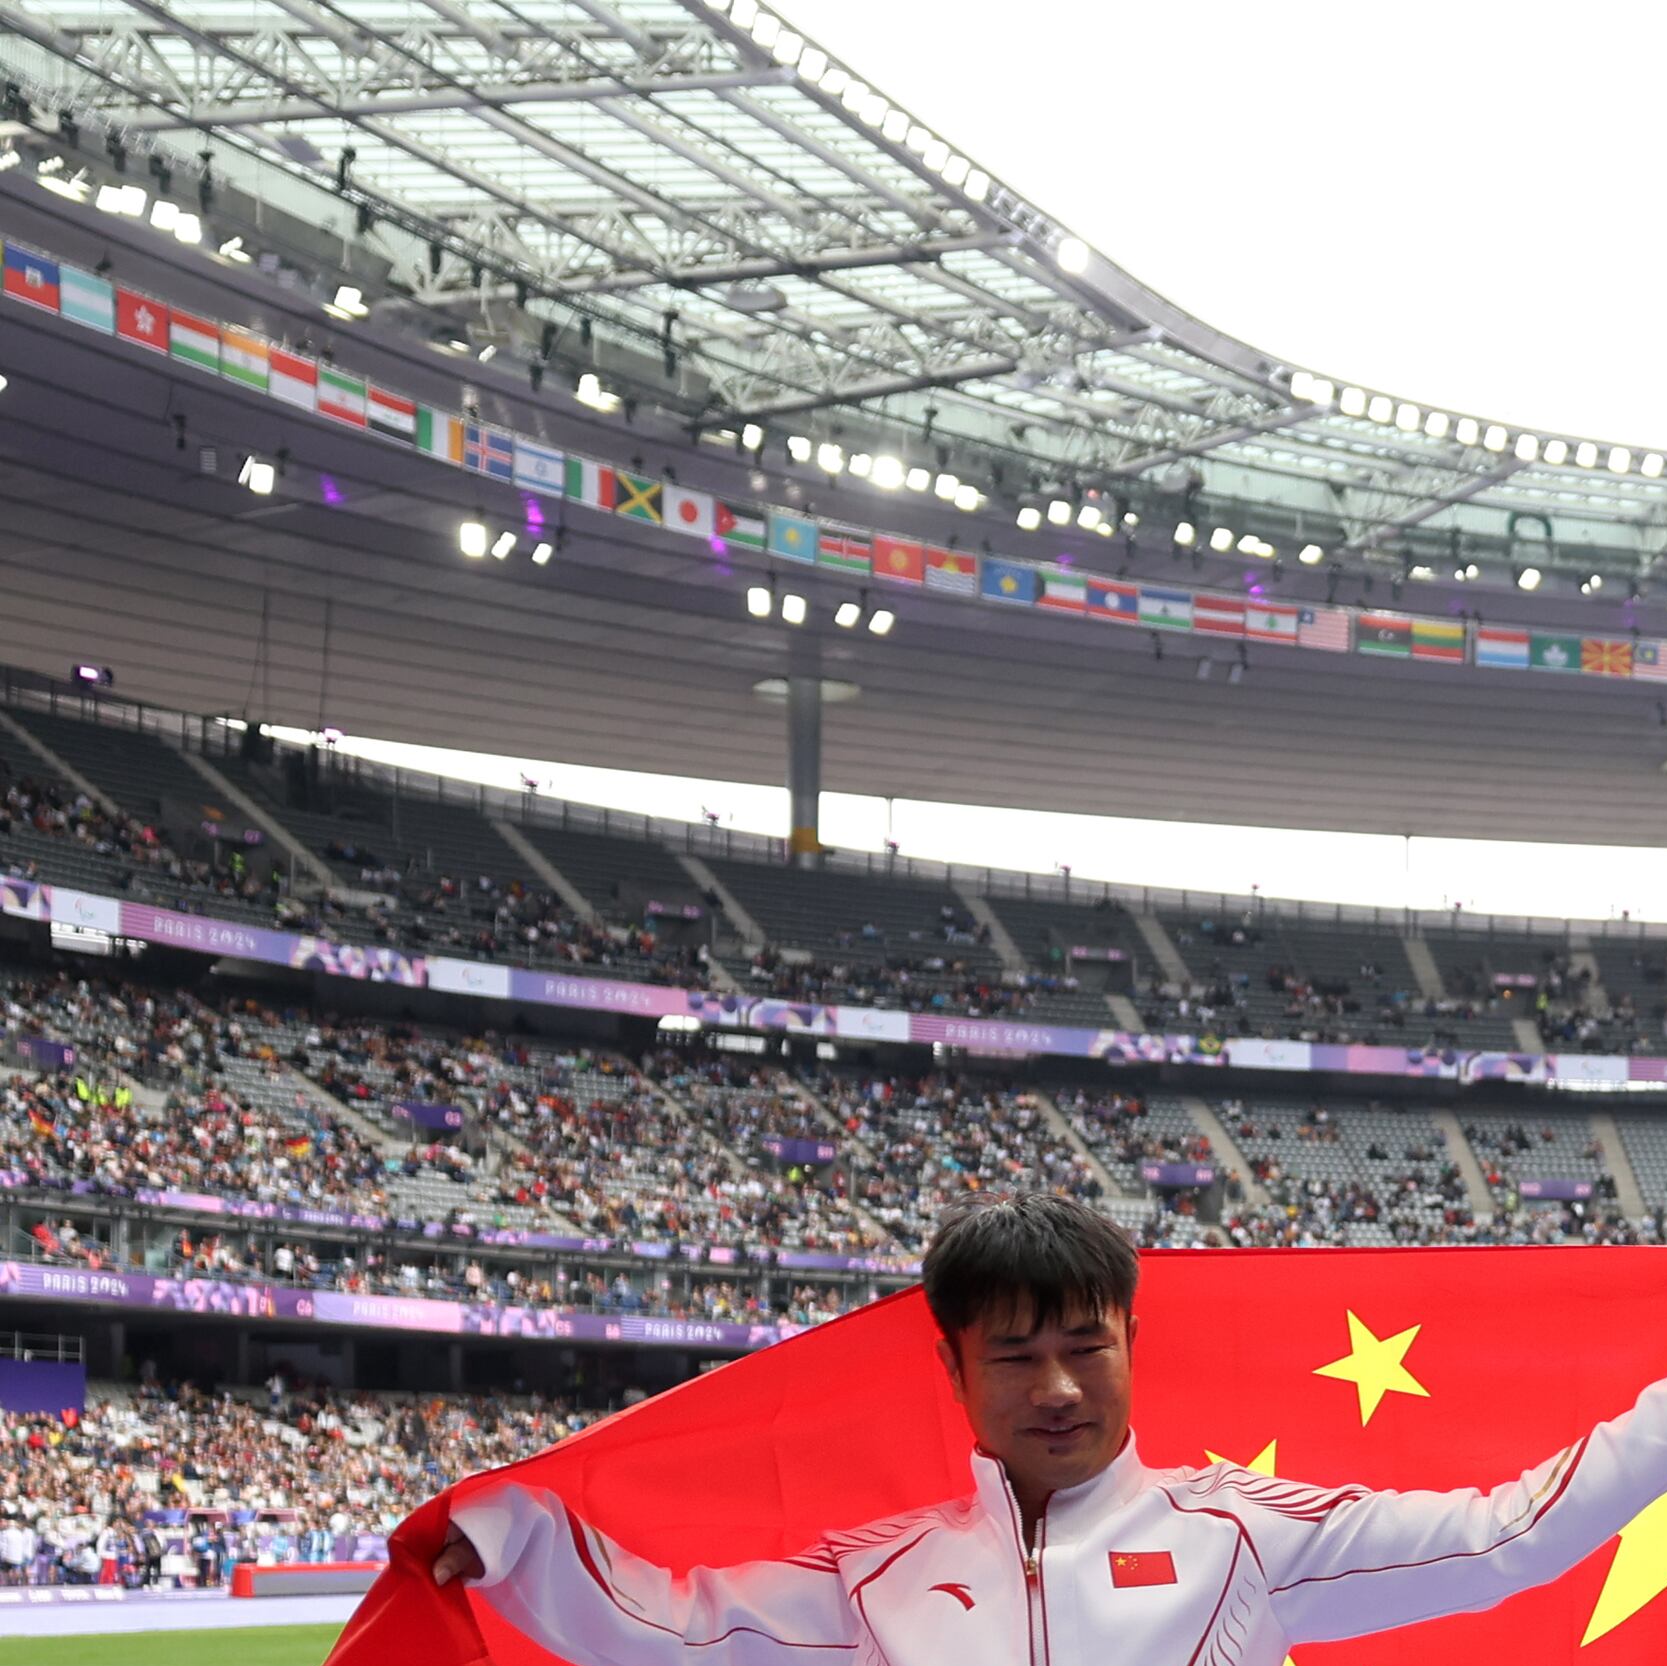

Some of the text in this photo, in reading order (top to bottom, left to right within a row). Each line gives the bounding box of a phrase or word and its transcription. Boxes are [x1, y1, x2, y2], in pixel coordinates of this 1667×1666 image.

[154, 915, 256, 951] PARIS 2024
[545, 980, 652, 1008] PARIS 2024
[945, 1023, 1053, 1046] PARIS 2024
[42, 1272, 130, 1298] PARIS 2024
[645, 1322, 725, 1341] PARIS 2024
